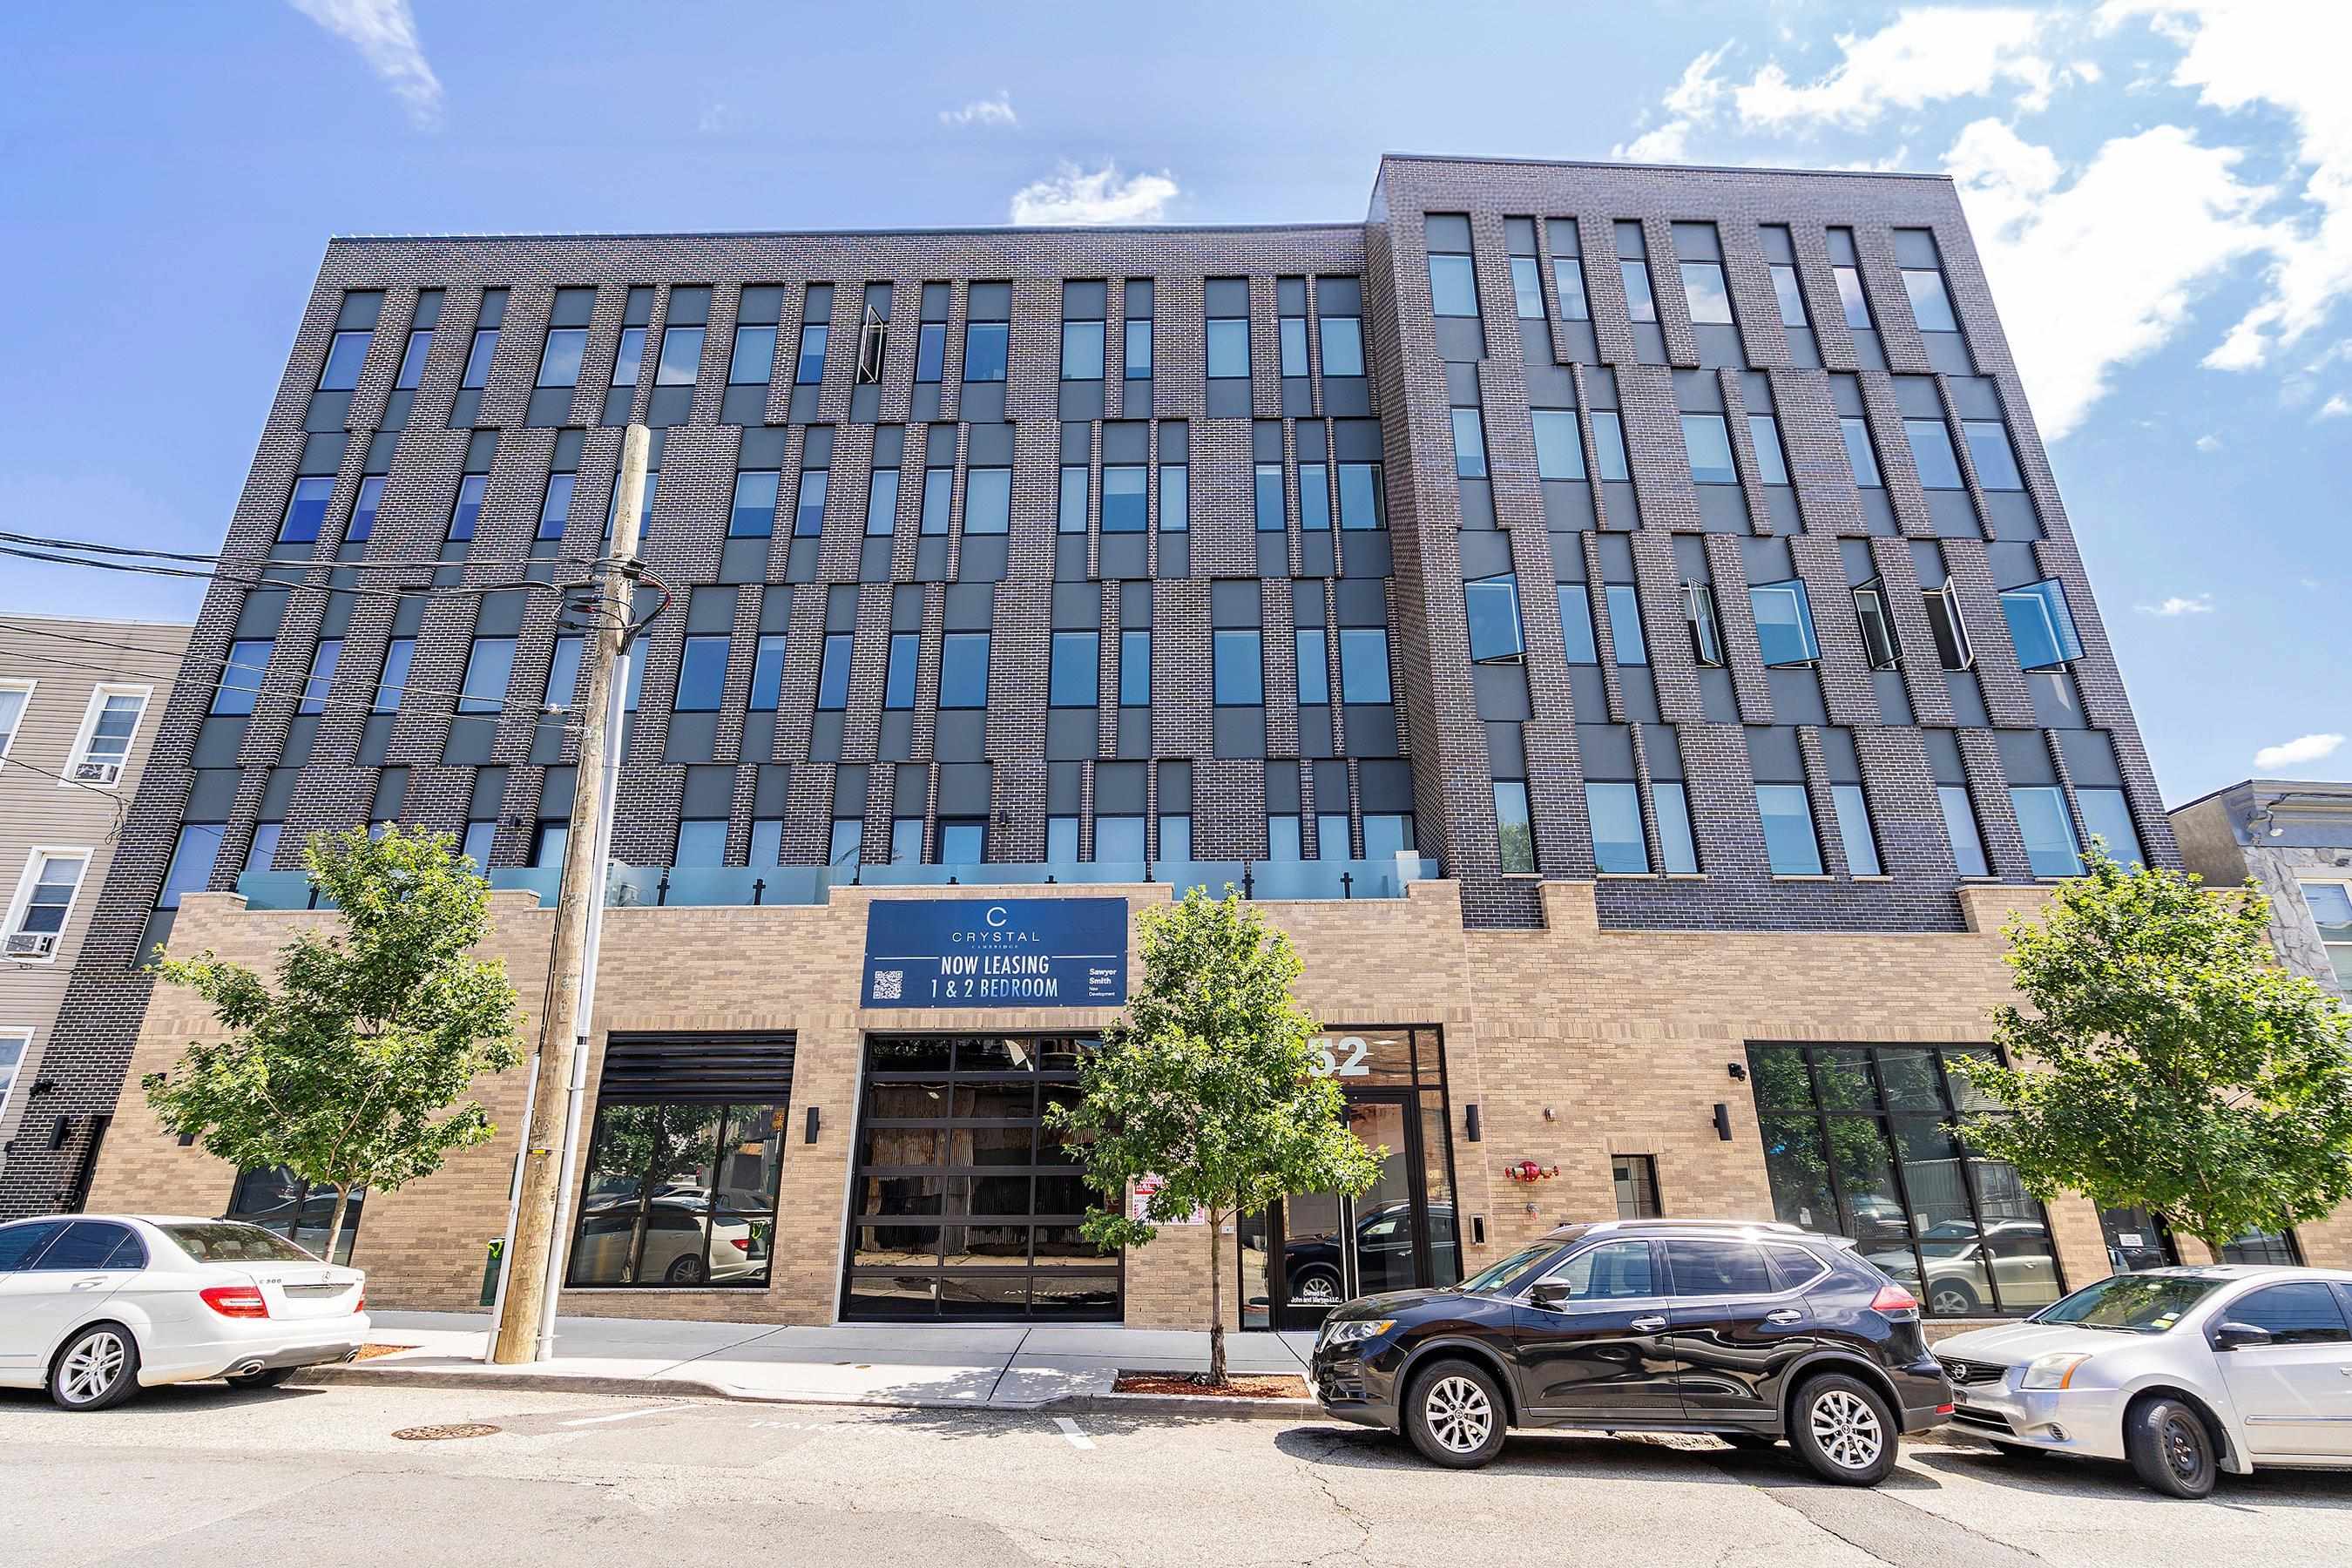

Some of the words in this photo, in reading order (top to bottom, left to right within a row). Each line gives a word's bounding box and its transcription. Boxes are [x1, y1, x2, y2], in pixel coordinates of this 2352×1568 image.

[986, 907, 1007, 927] C
[952, 931, 1040, 943] CRYSTAL
[941, 956, 978, 975] NOW
[984, 955, 1050, 975] LEASING
[1089, 968, 1117, 977] Sawyer
[931, 979, 937, 998] 1
[946, 980, 957, 997] &
[964, 979, 974, 997] 2
[981, 978, 1058, 997] BEDROOM
[1308, 1037, 1369, 1077] 52
